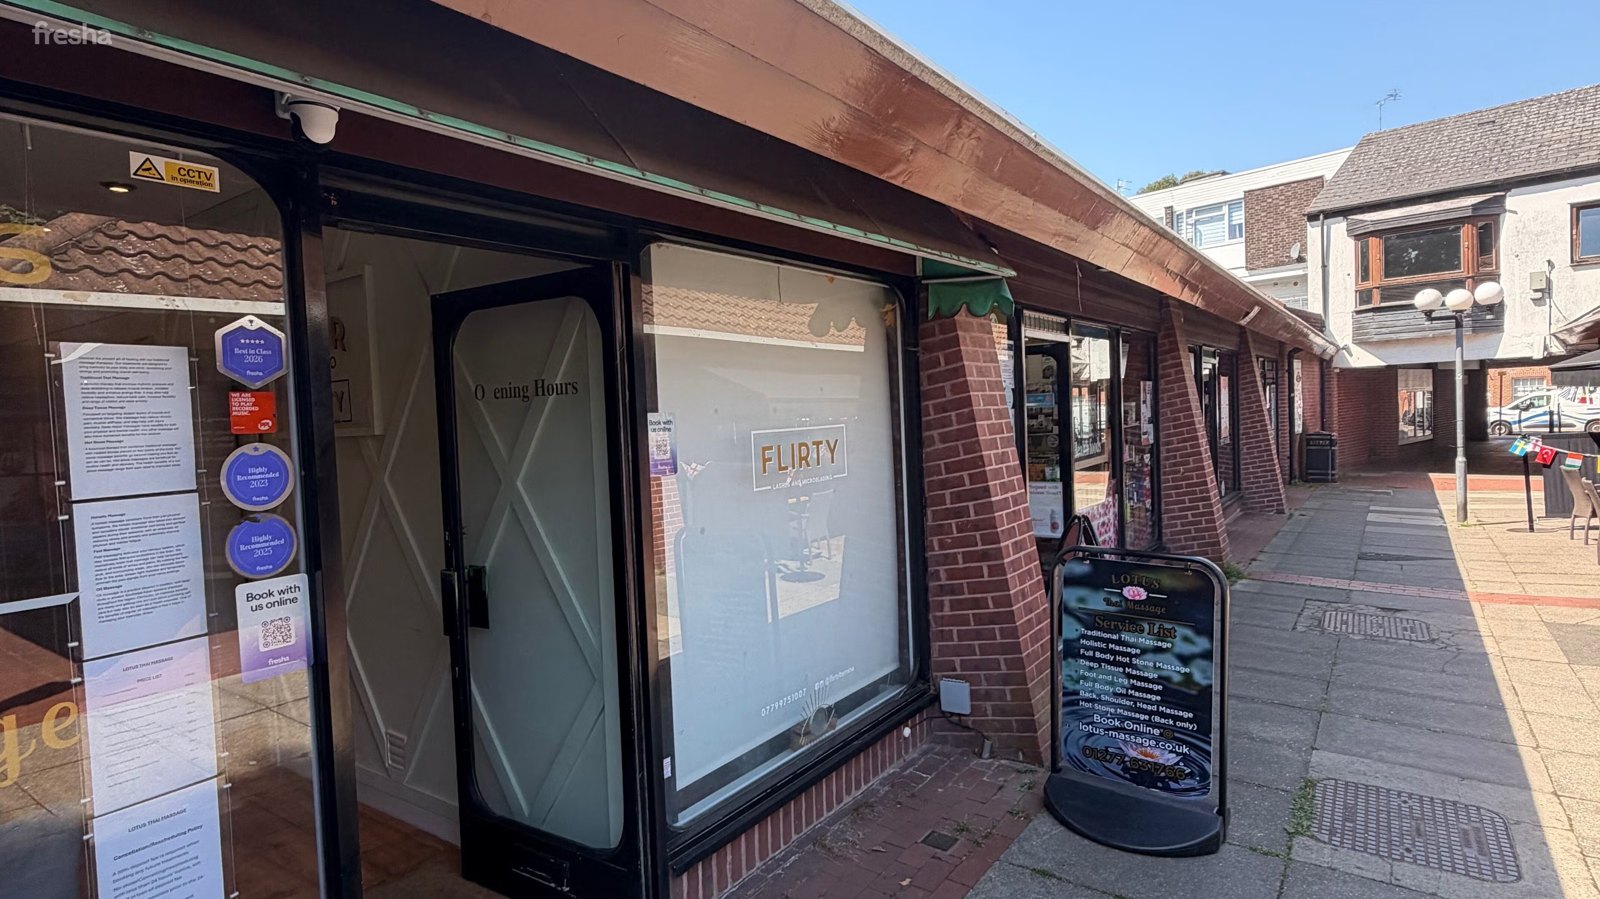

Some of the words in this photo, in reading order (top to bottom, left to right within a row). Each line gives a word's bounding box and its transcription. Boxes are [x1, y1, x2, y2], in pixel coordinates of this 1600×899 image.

[177, 167, 213, 182] CCTV
[179, 176, 214, 188] operation
[244, 355, 263, 363] 2026
[534, 378, 579, 397] Hours
[761, 438, 840, 476] FLIRTY
[237, 472, 279, 481] Recommended
[248, 466, 268, 475] Highly
[240, 538, 285, 551] Recommended
[251, 534, 272, 543] Highly
[253, 547, 273, 557] 2025
[1111, 574, 1161, 589] LOTUS
[246, 588, 275, 602] Book
[277, 584, 301, 595] with
[250, 603, 263, 612] us
[265, 596, 298, 609] online
[1126, 601, 1167, 615] Massage
[1095, 615, 1145, 634] Service
[1147, 623, 1177, 640] List
[1080, 628, 1119, 641] Traditional
[1120, 634, 1137, 644] Thai
[1138, 637, 1172, 649] Massage
[1080, 638, 1107, 649] Holistic
[1108, 643, 1141, 655] Massage
[268, 655, 290, 665] fresha
[1080, 648, 1094, 657] Full
[1095, 651, 1114, 662] Body
[1115, 655, 1130, 664] Hot
[1131, 657, 1154, 668] Stone
[1155, 661, 1190, 674] Massage
[1080, 659, 1099, 670] Deep
[1101, 662, 1124, 673] Tissue
[1125, 666, 1158, 679] Massage
[1080, 669, 1096, 679] Foot
[1098, 672, 1112, 681] and
[1113, 675, 1128, 685] Leg
[1130, 678, 1163, 691] Massage
[1080, 679, 1093, 688] Full
[1094, 682, 1114, 693] Body
[1115, 685, 1126, 694] Oil
[1128, 689, 1161, 701] Massage
[1100, 693, 1135, 708] Shoulder,
[1137, 701, 1157, 712] Head
[1159, 705, 1194, 719] Massage
[1080, 700, 1093, 708] Hot
[1094, 702, 1115, 713] Stone
[1117, 706, 1149, 720] Massage
[1151, 714, 1174, 726] (Back
[1176, 719, 1197, 731] only)
[1093, 714, 1122, 728] Book
[1124, 720, 1160, 736] Online
[1079, 722, 1190, 755] lotus-massage.co.uk
[128, 822, 147, 833] LOTUS
[161, 808, 187, 821] MASSAGE
